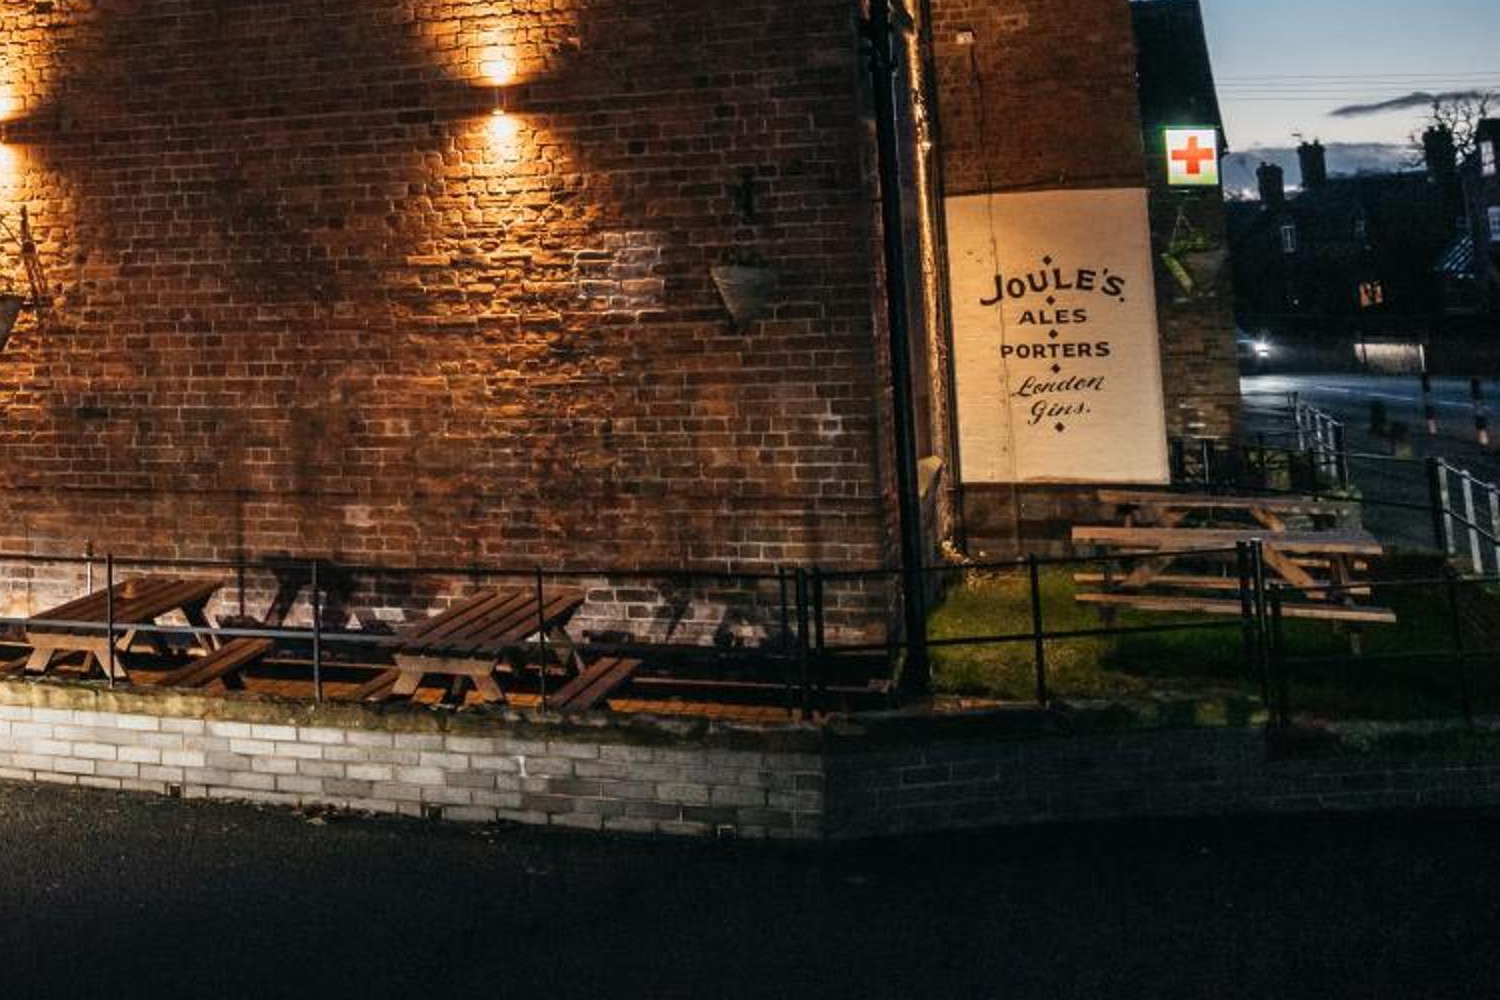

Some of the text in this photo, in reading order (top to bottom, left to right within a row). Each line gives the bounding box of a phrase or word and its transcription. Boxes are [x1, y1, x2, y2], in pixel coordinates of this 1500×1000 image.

[1019, 309, 1087, 325] ALES
[1001, 342, 1111, 358] PORTERS
[1011, 375, 1105, 397] London
